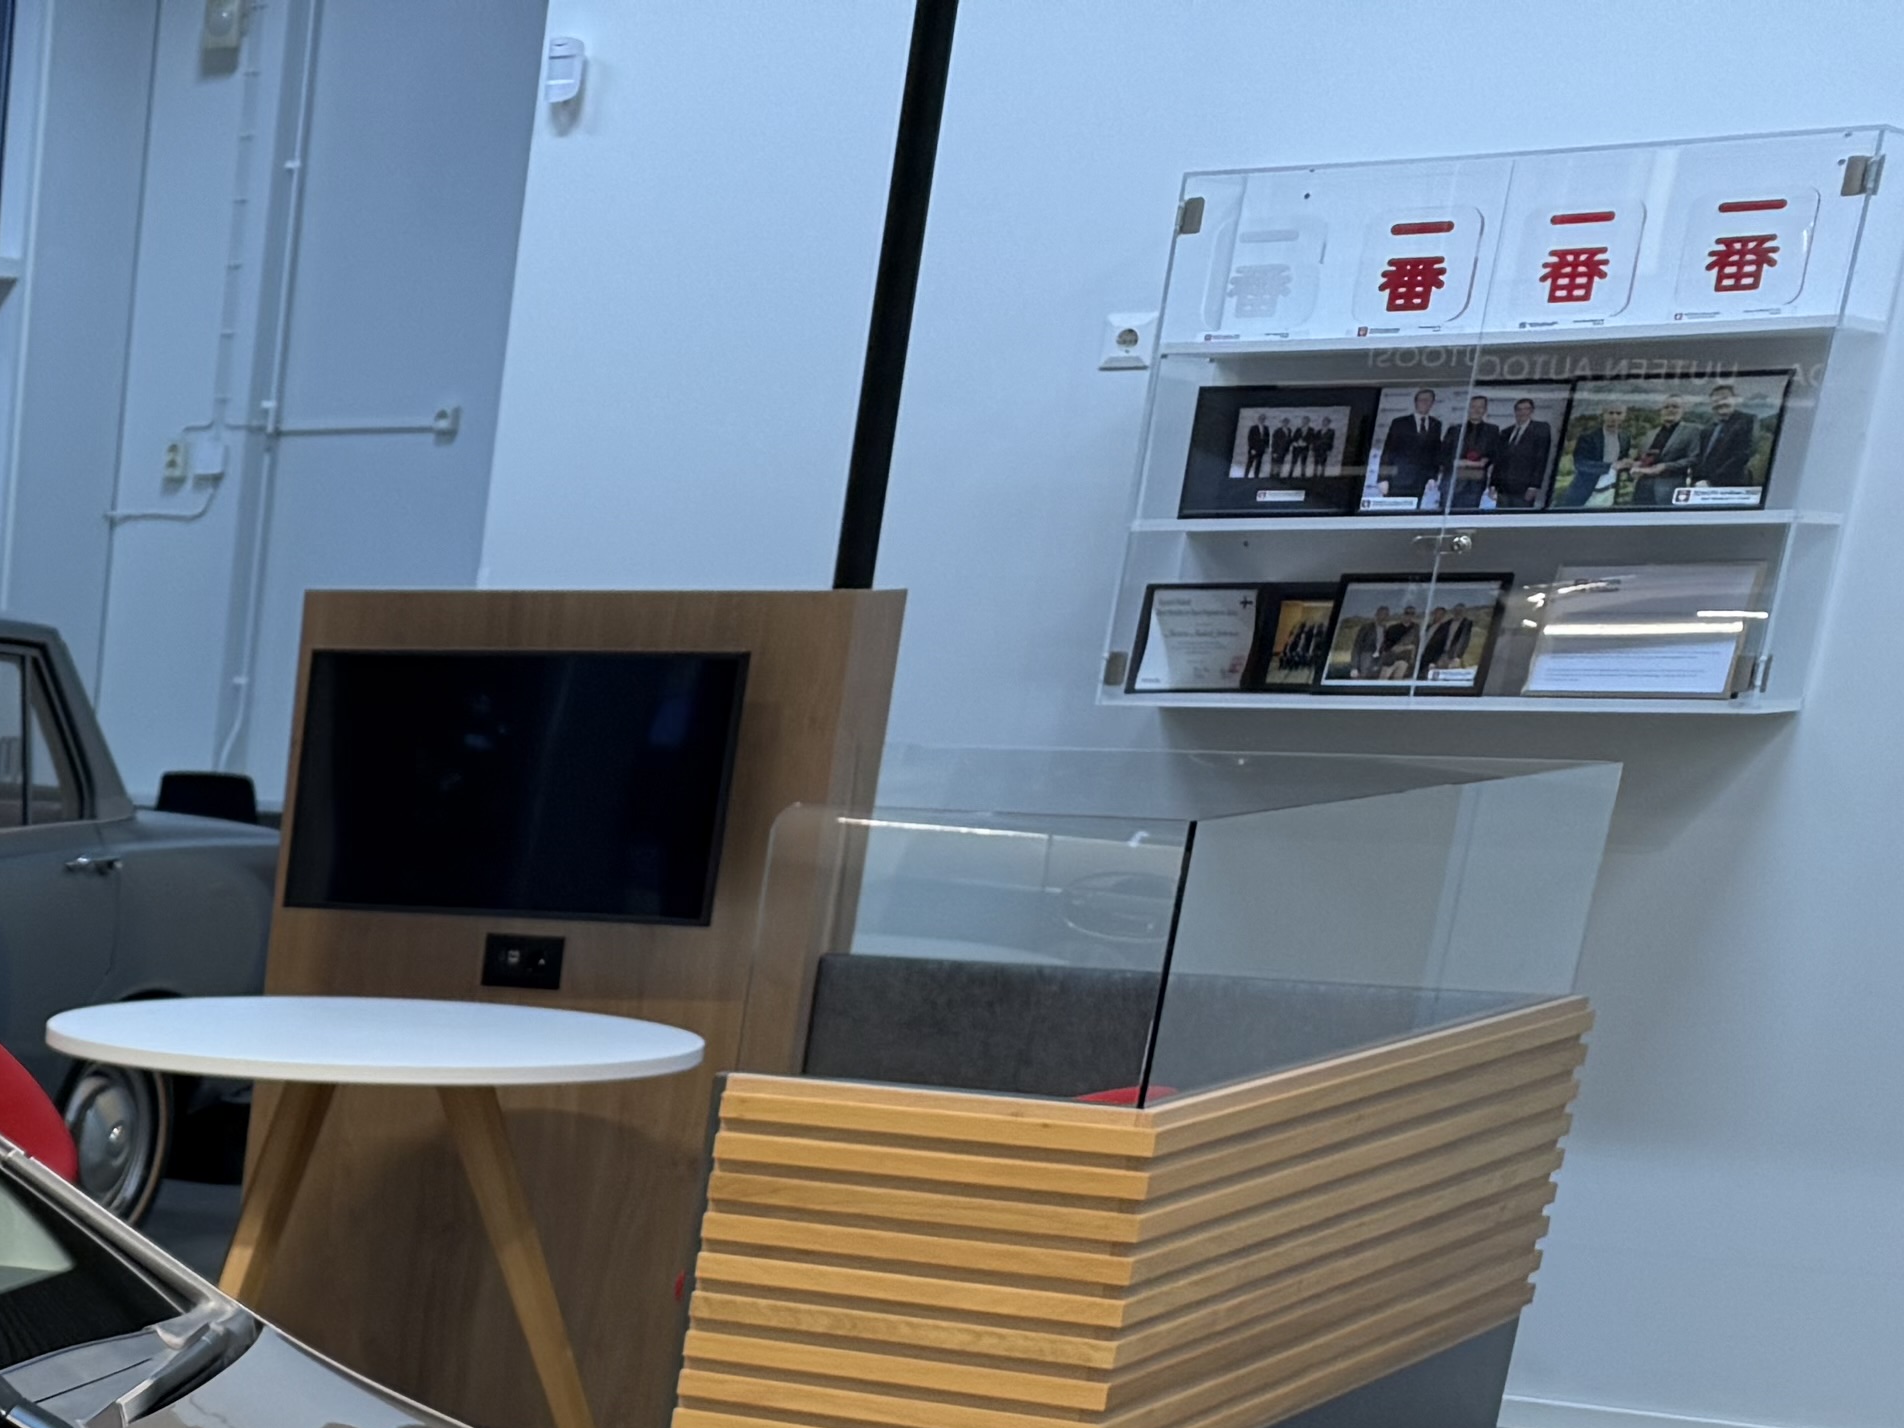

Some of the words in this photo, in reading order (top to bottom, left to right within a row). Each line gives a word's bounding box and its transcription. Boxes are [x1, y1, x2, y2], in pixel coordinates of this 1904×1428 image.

[1378, 220, 1454, 312] 一番
[1539, 210, 1616, 303] 一番
[1705, 198, 1788, 292] 一番
